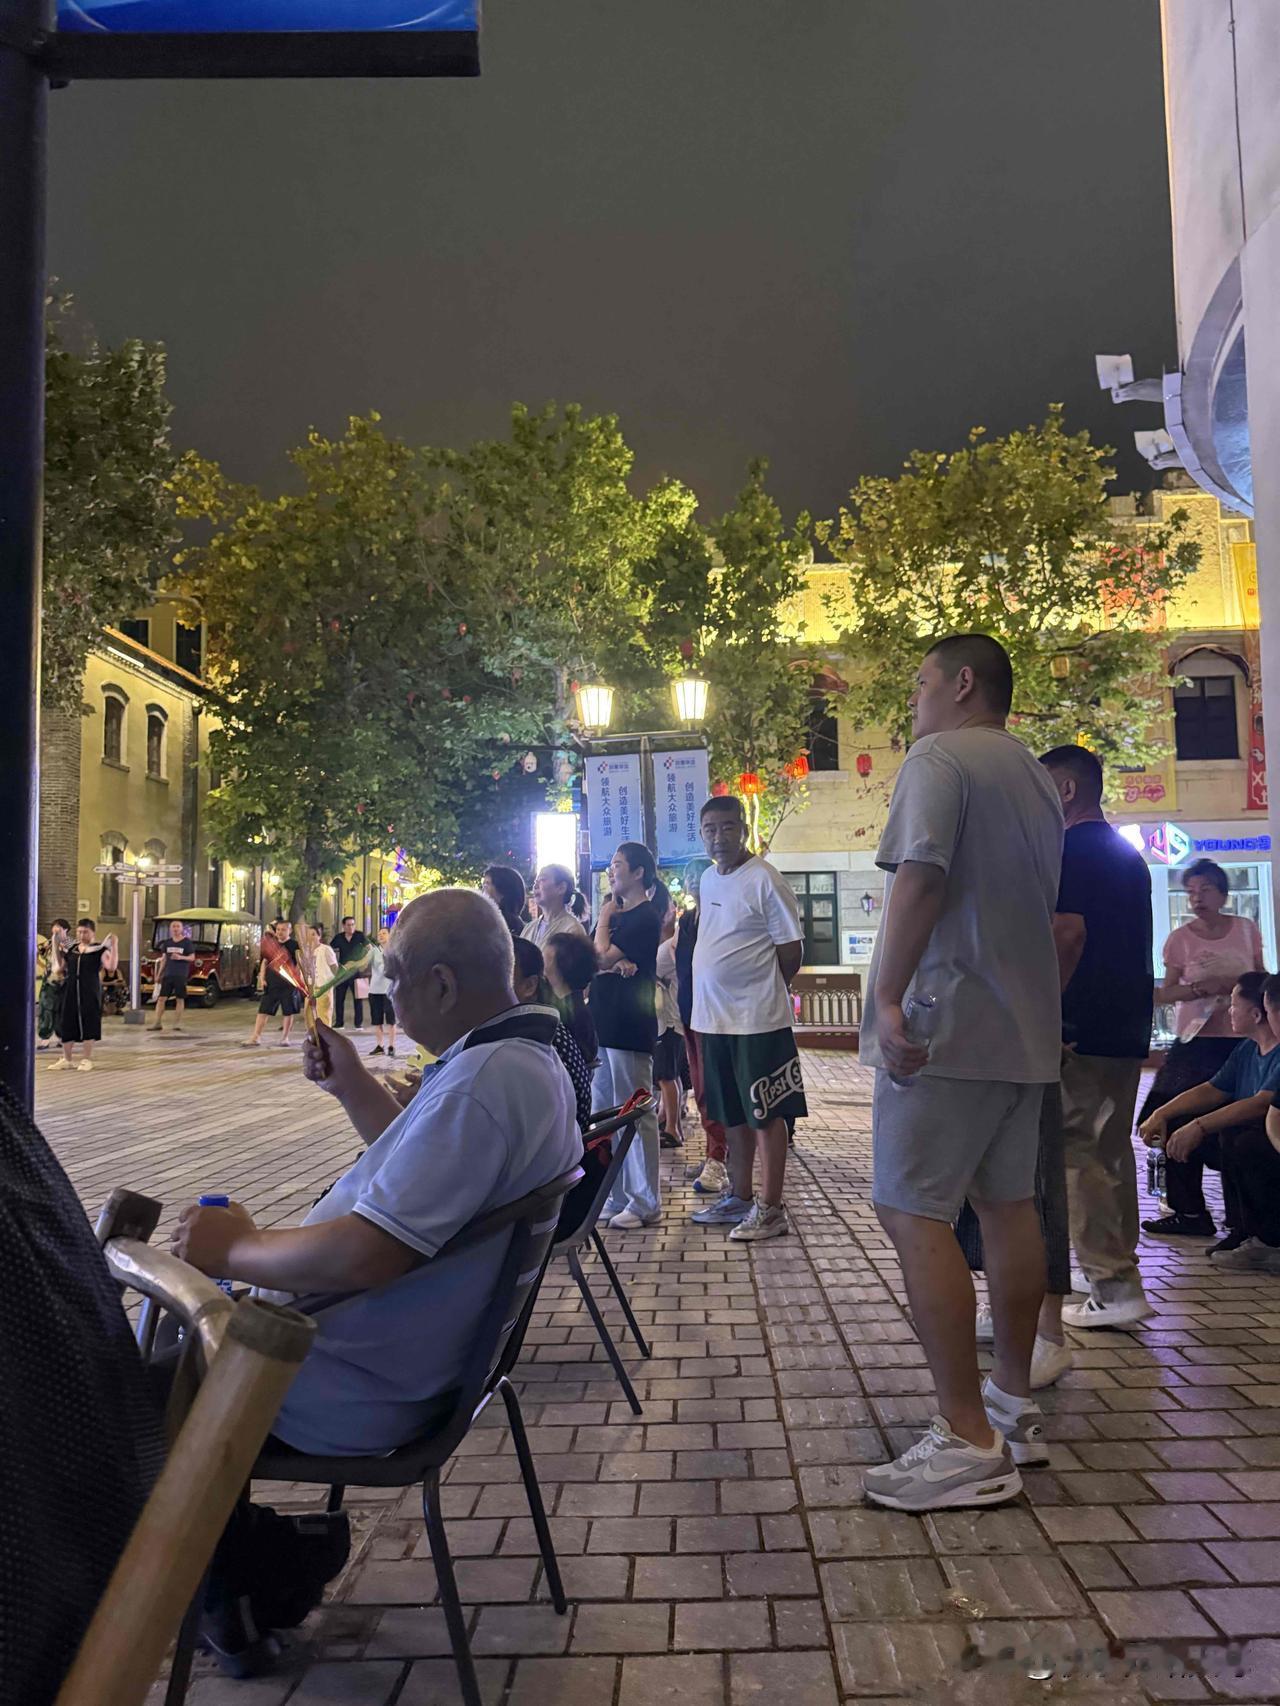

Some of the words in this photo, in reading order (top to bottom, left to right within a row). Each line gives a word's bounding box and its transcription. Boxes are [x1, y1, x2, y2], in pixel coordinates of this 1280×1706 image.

[666, 773, 678, 833] 领航大众旅游
[684, 781, 697, 842] 创造美好生活
